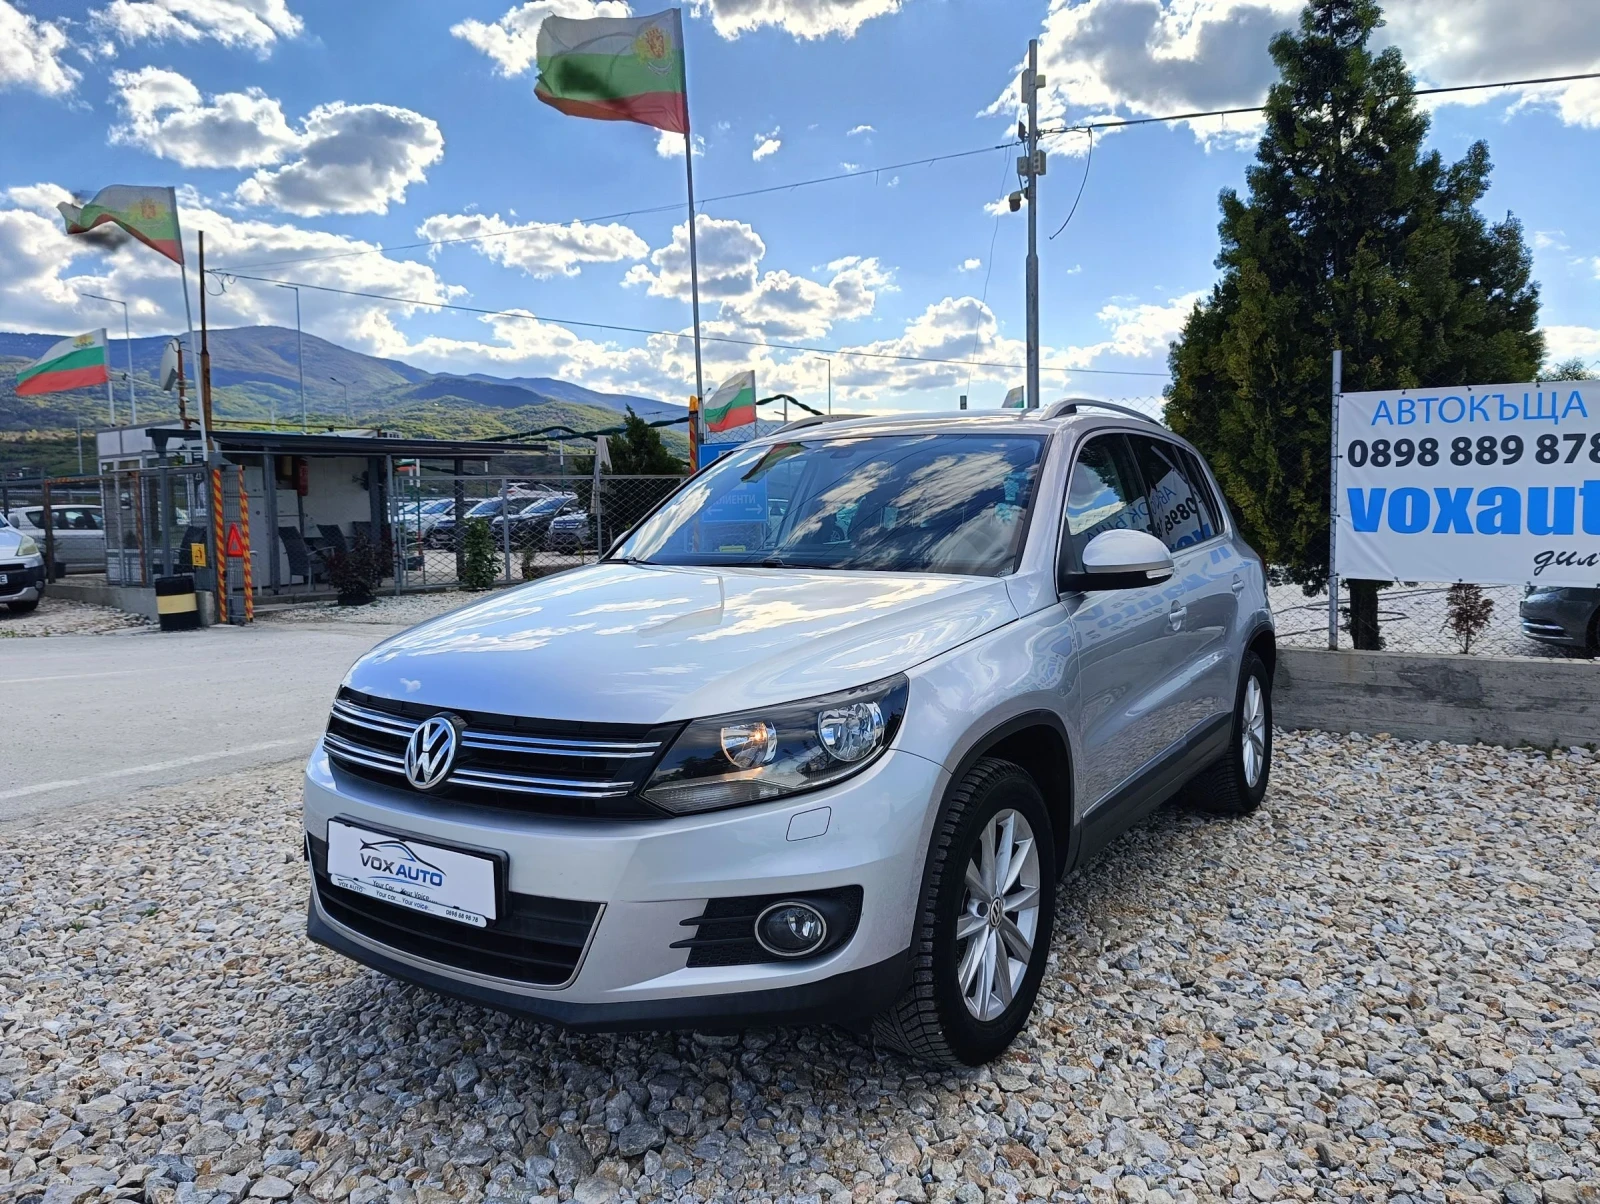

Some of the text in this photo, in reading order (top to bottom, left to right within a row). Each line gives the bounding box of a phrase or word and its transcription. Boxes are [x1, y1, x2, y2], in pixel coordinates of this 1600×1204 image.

[1371, 390, 1589, 426] АВТОКЪЩА
[1347, 437, 1440, 468] 0898
[1450, 434, 1524, 466] 889
[1533, 549, 1600, 577] дил
